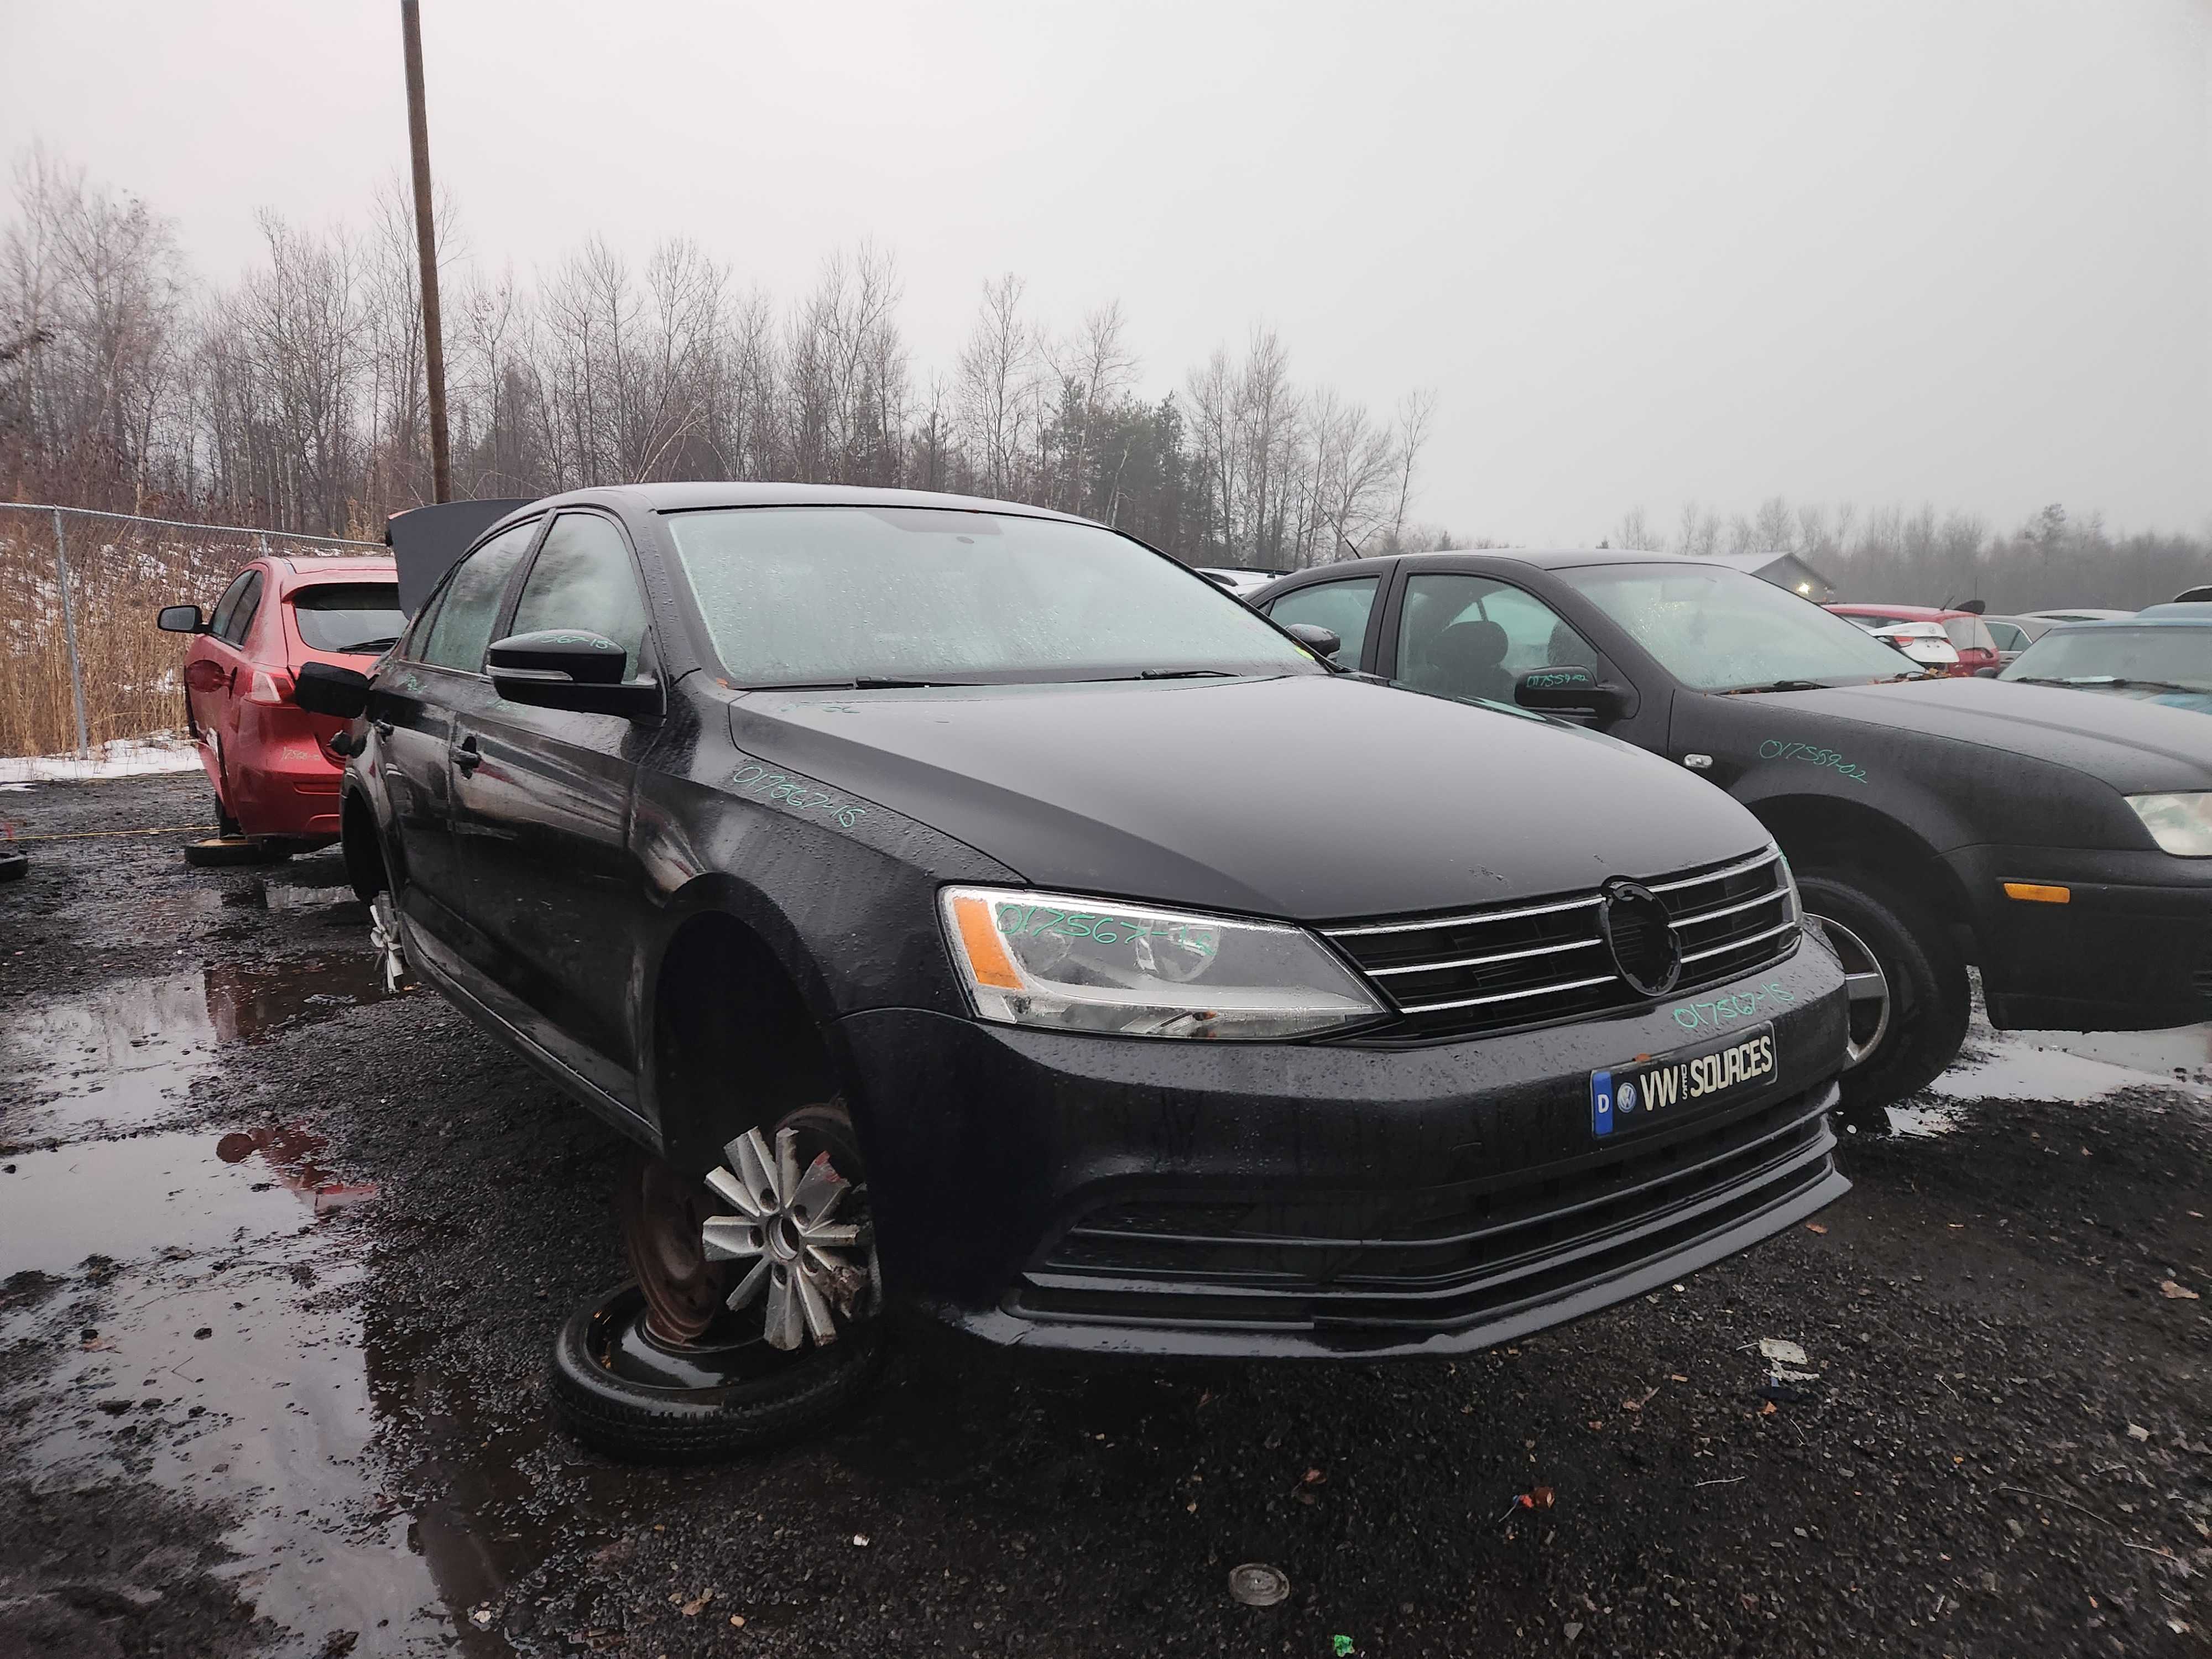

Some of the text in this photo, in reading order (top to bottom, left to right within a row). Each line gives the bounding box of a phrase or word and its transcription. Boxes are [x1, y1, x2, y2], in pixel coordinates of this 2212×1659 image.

[1640, 1066, 1678, 1111] VW
[1690, 1035, 1773, 1098] SOURCES
[1597, 1094, 1610, 1114] D
